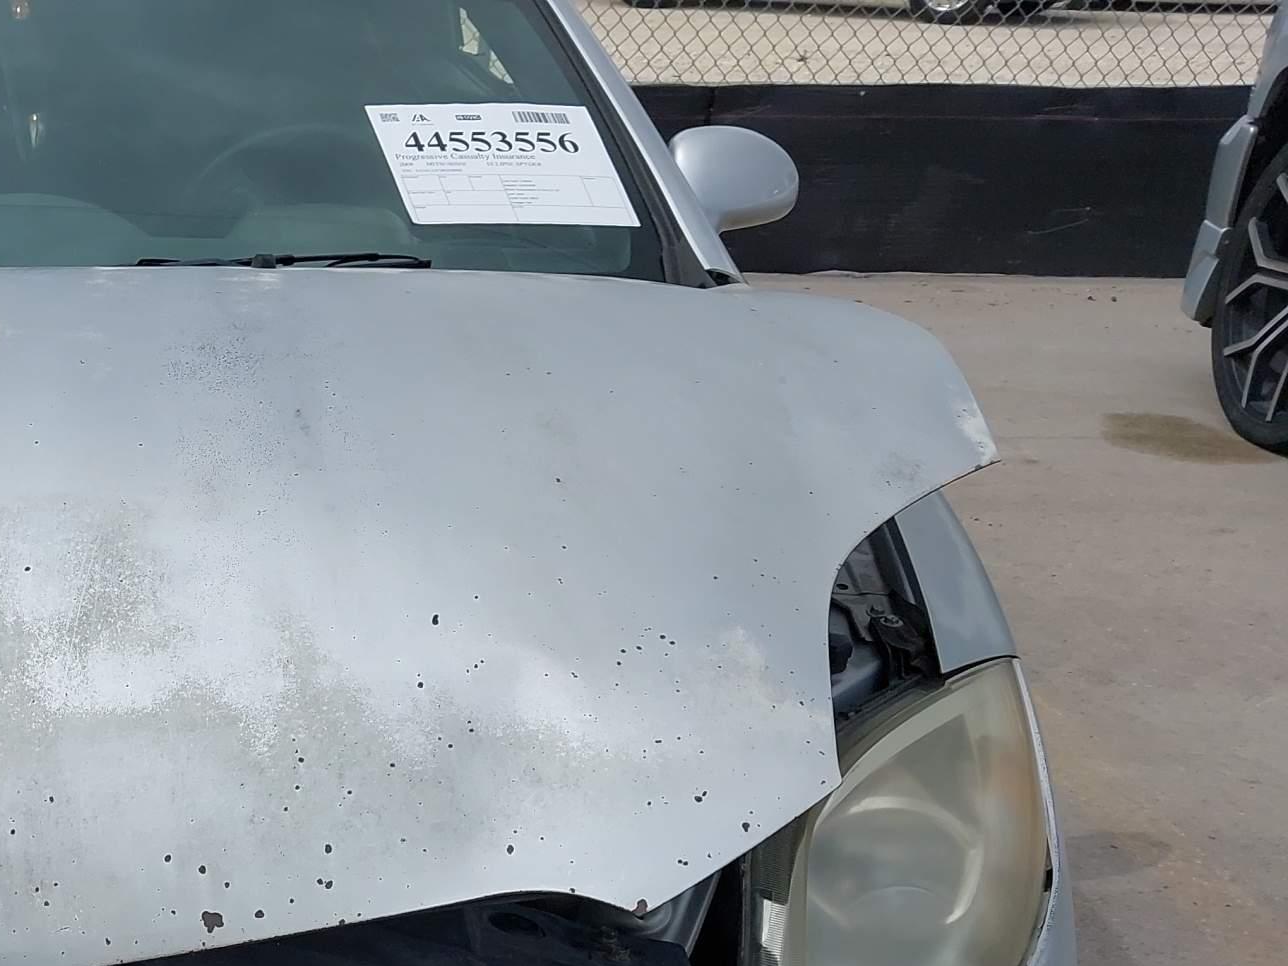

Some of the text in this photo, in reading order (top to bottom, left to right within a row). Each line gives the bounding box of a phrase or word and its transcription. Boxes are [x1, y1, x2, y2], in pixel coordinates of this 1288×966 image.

[404, 131, 579, 154] 44553556
[395, 153, 448, 161] Progressive
[450, 153, 490, 161] Casualty
